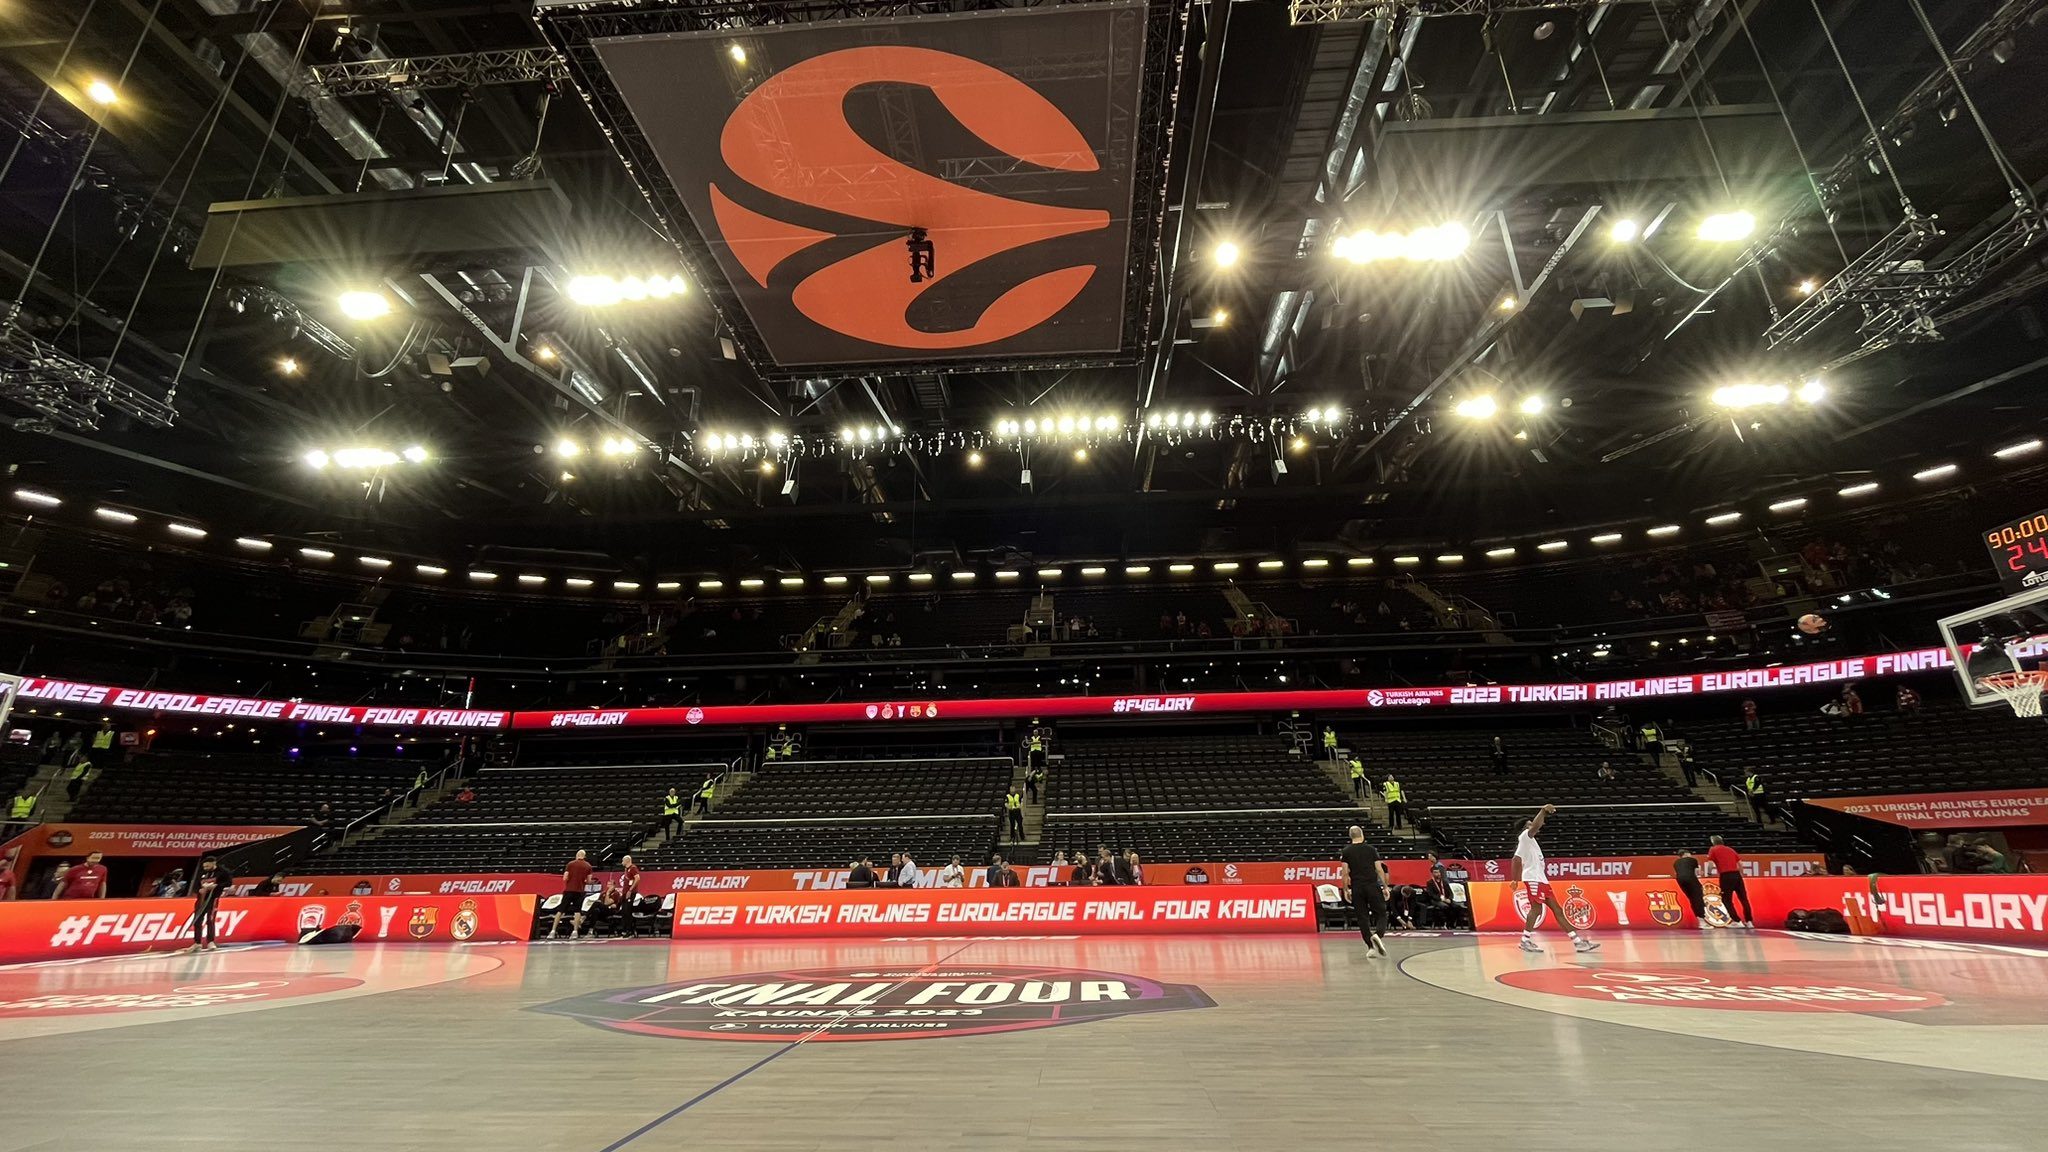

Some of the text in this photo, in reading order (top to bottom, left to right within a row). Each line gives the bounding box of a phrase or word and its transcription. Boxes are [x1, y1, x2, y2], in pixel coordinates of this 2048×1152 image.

[1988, 514, 2048, 549] 90:00
[2006, 537, 2048, 571] 24
[1450, 687, 1501, 704] 2023
[1507, 684, 1588, 703] TURKISH
[1594, 675, 1693, 700] AIRLINES
[1702, 659, 1866, 692] EUROLEAGUE
[1875, 648, 1956, 675] FINAL
[1385, 689, 1444, 698] TURKISH AIRLINES
[112, 689, 286, 718] EUROLEAGUE
[288, 703, 354, 723] FINAL
[360, 708, 416, 725] FOUR
[421, 710, 503, 727] KAUNAS
[1112, 697, 1196, 713] #F4GLORY
[550, 711, 629, 726] #F4GLORY
[1844, 805, 1871, 814] 2023
[1873, 802, 1927, 812] TURKISH
[1930, 800, 1989, 810] AIRLINES
[1897, 808, 2031, 821] FINAL FOUR KAUNAS
[89, 831, 115, 840] 2023
[117, 832, 164, 840] TURKISH
[166, 832, 215, 841] AIRLINES
[132, 840, 164, 848] FINAL
[166, 840, 196, 848] FOUR
[1547, 862, 1632, 876] #F4GLORY
[439, 880, 515, 893] #F4GLORY
[672, 876, 750, 889] #F4GLORY
[679, 899, 1306, 925] 2023 TURKISH AIRLINES EUROLEAGUE FINAL FOUR KAUNAS
[638, 980, 1131, 1005] FINAL FOUR
[714, 1009, 876, 1017] KAUNAS
